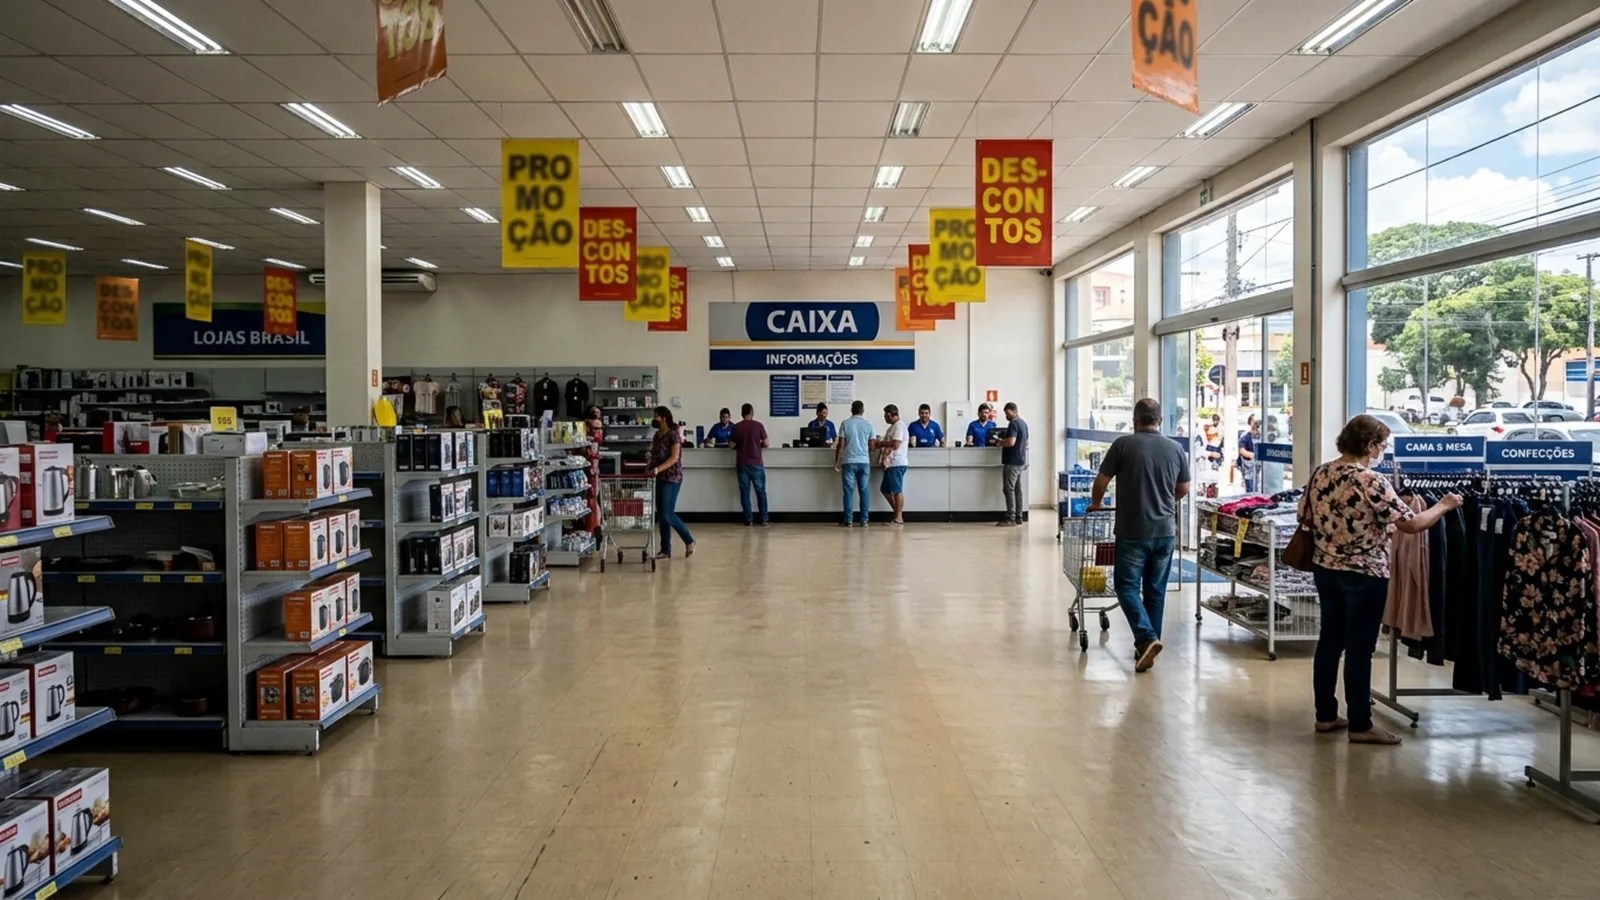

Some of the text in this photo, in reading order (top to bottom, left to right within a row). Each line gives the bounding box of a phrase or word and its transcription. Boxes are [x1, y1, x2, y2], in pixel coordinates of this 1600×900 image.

[508, 153, 573, 181] PRO
[982, 156, 1047, 184] DES-
[516, 185, 565, 211] MO
[982, 186, 1045, 214] CON
[508, 212, 574, 252] ÇÃO
[583, 219, 633, 238] DES-
[984, 217, 1042, 244] TOS
[583, 241, 631, 261] CON
[585, 264, 629, 284] TOS
[767, 310, 858, 332] CAIXA
[193, 331, 246, 345] LOJAS
[1405, 442, 1435, 452] CAMA
[1446, 442, 1473, 452] MESA
